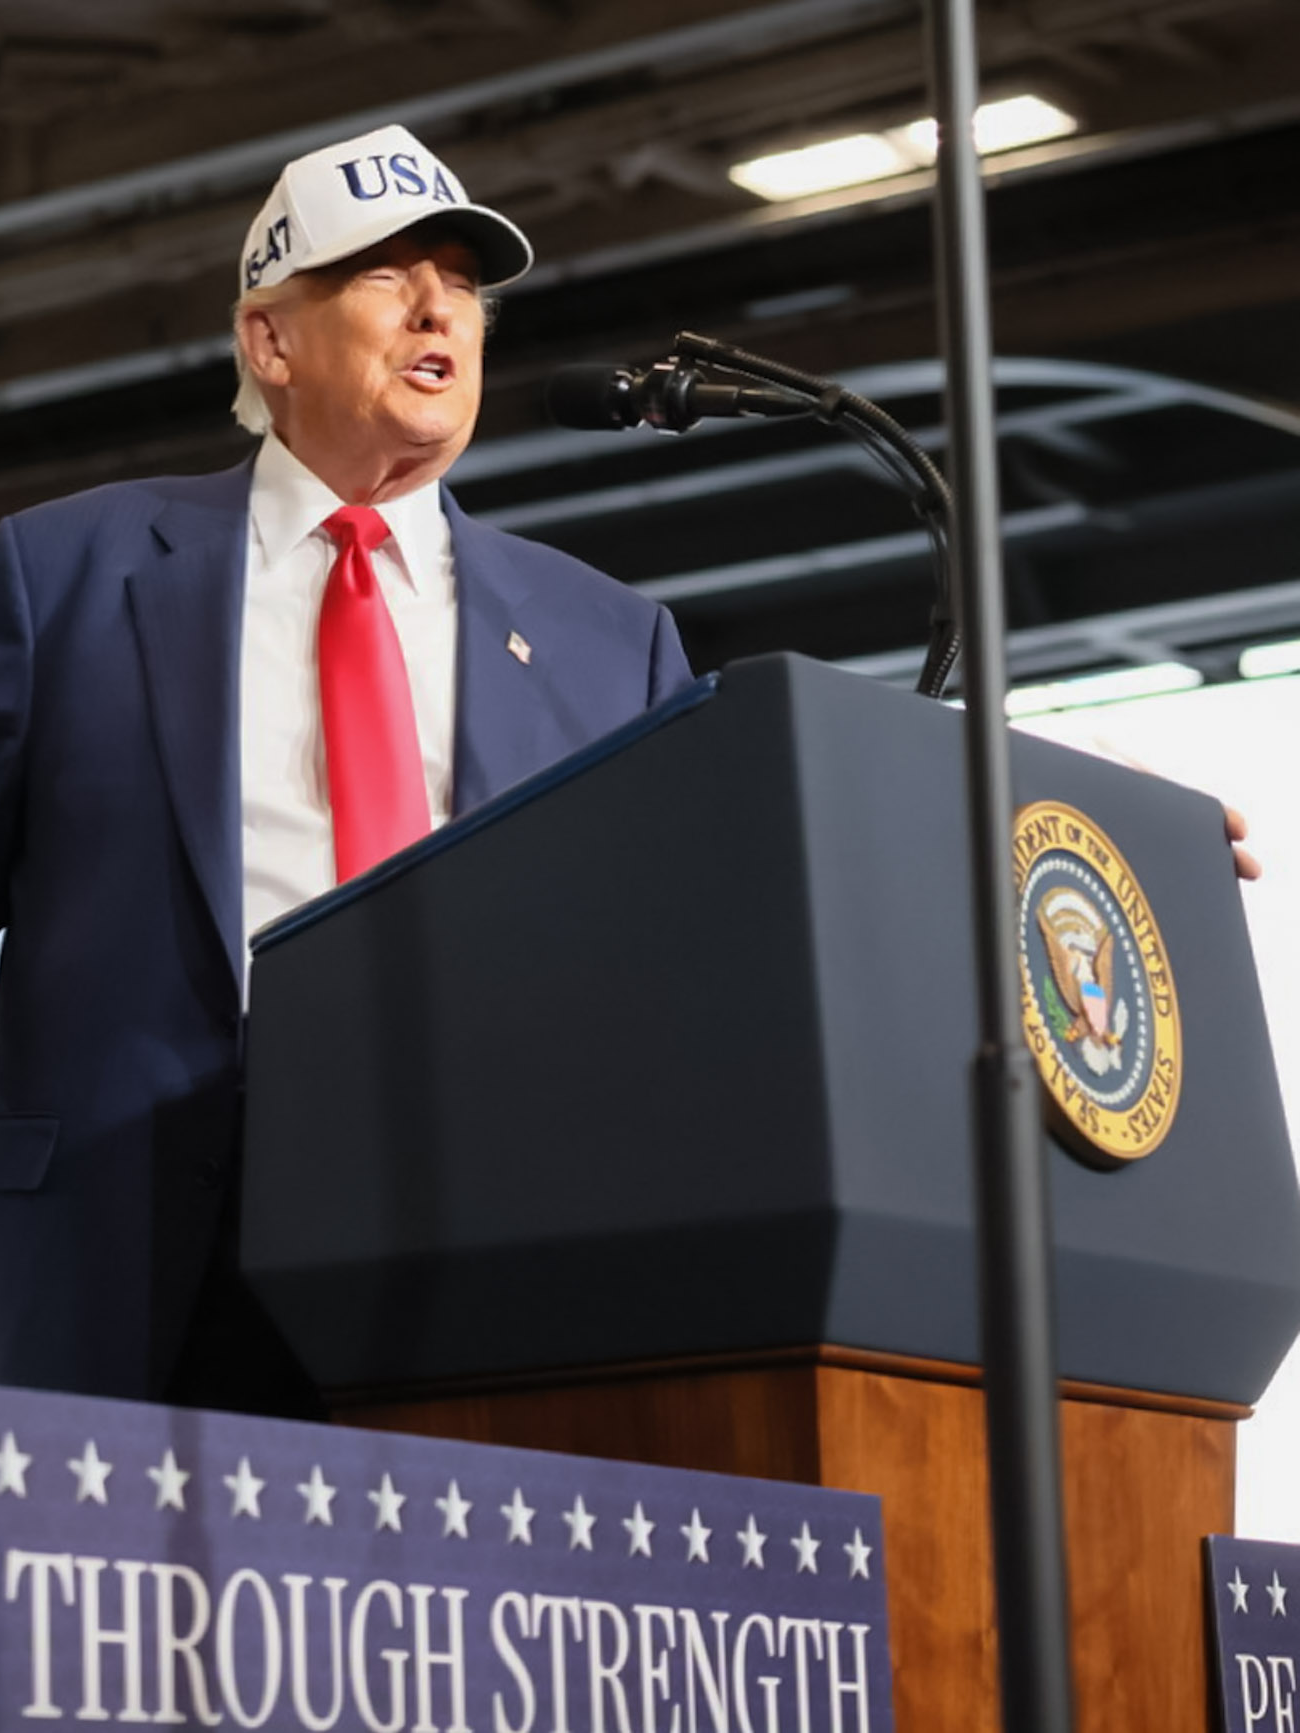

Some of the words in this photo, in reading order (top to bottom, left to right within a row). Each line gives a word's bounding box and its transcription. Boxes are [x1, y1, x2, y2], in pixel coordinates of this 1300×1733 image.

[336, 153, 457, 204] USA
[1117, 871, 1170, 1018] UNITED
[1050, 1053, 1101, 1135] SEAL
[1127, 1046, 1174, 1143] STATES
[6, 1548, 472, 1733] THROUGH
[490, 1590, 871, 1733] STRENGTH
